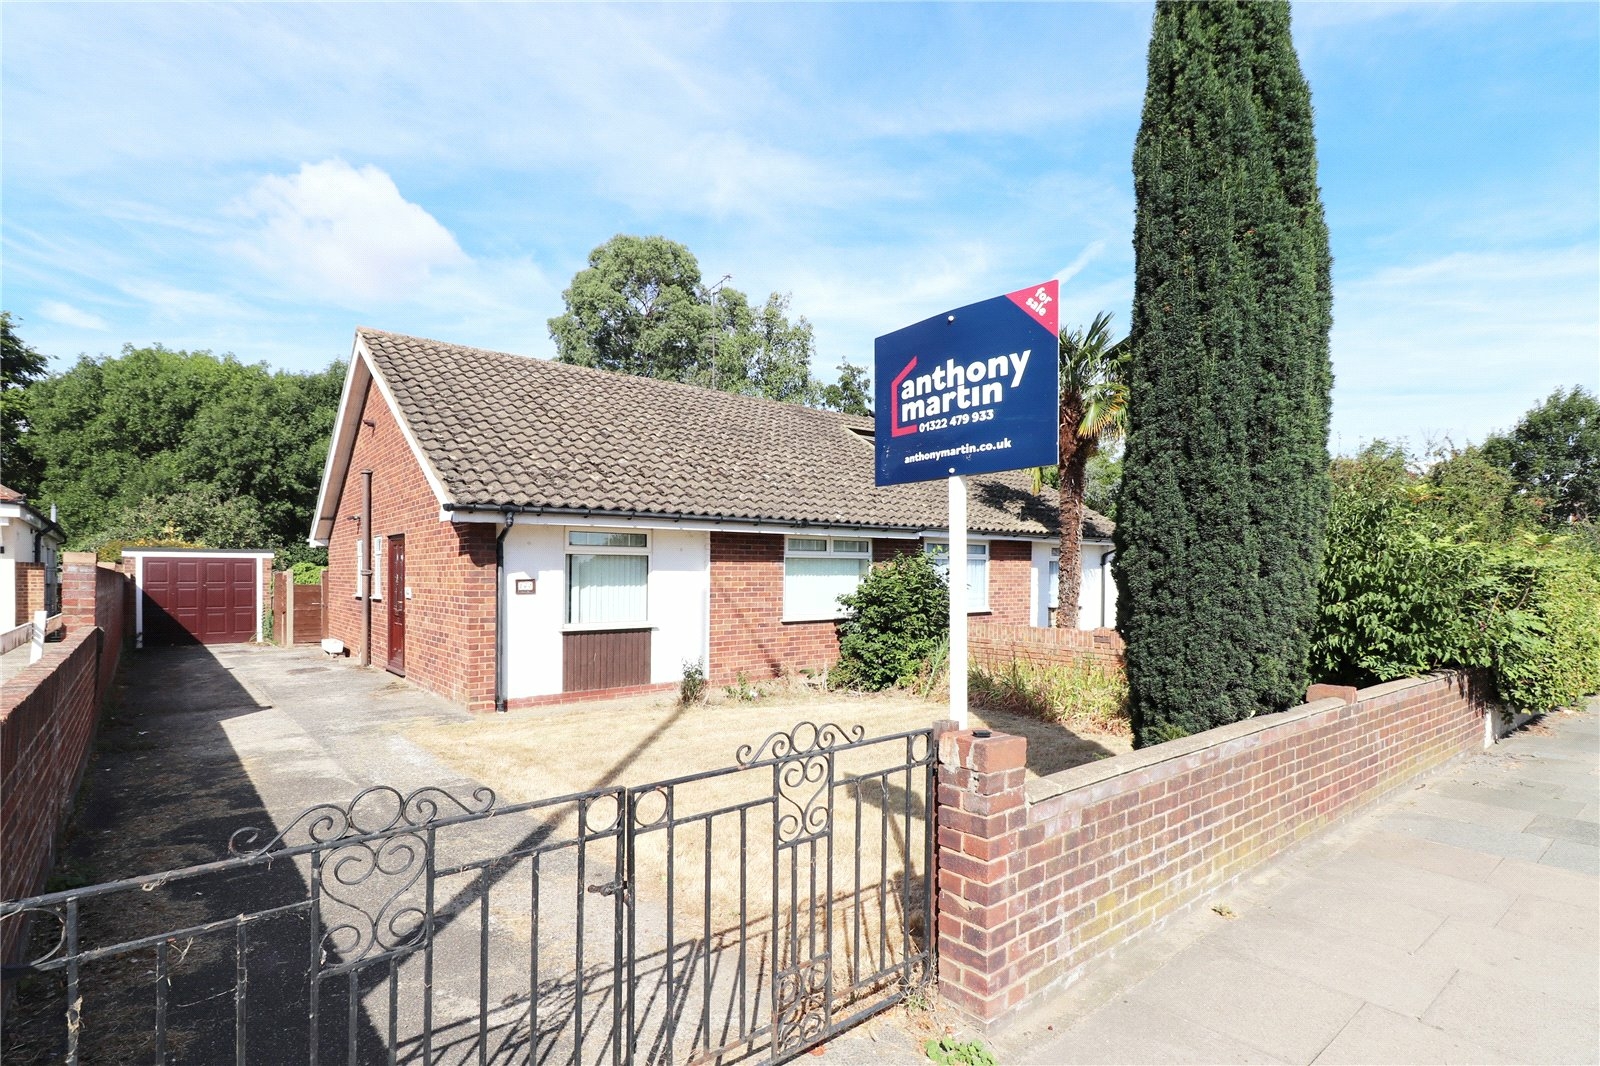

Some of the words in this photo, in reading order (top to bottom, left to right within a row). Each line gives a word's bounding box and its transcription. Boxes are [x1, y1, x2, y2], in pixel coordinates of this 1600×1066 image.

[1026, 296, 1046, 316] sale
[1034, 287, 1052, 304] for
[901, 350, 1032, 399] anthony
[902, 381, 1002, 422] martin
[919, 418, 948, 433] 01322
[950, 412, 969, 426] 479
[972, 409, 994, 423] 933
[904, 438, 1012, 464] anthonymartin.co.uk
